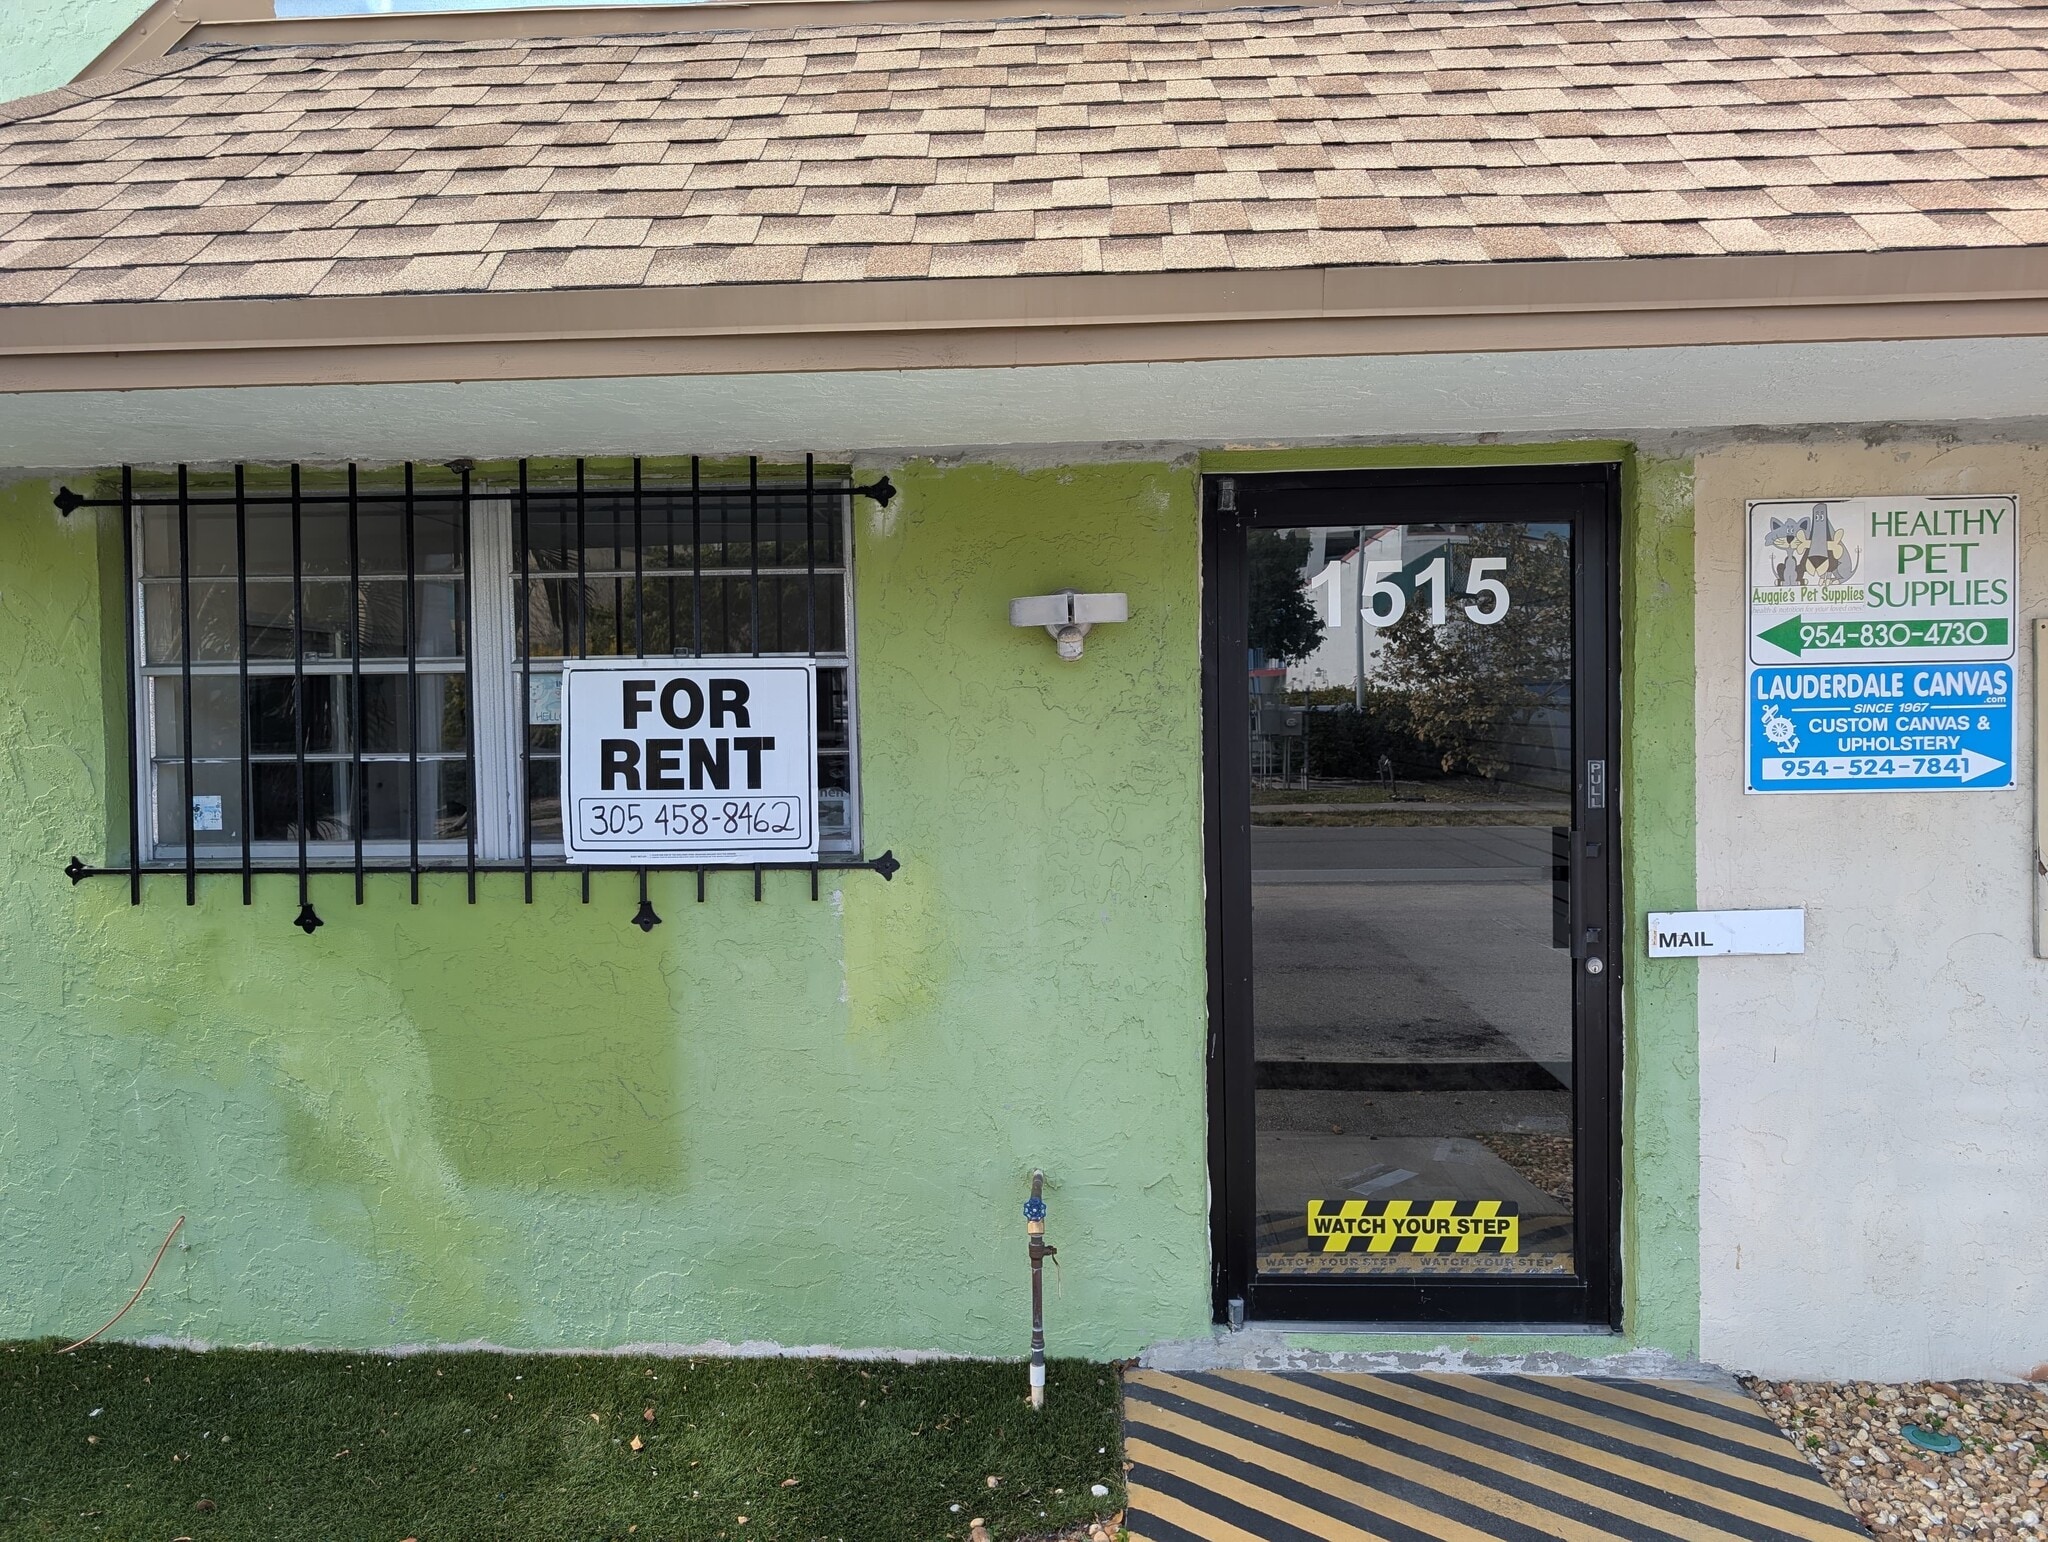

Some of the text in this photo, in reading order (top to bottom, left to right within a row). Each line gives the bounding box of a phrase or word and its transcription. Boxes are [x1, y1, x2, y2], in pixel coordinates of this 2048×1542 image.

[1871, 508, 2006, 537] HEALTHY
[1897, 542, 1979, 574] PET
[1311, 557, 1511, 628] 1515
[1752, 586, 1865, 605] Auggie's Pet Supplies
[1867, 578, 2008, 608] SUPPLIES
[1799, 621, 1988, 648] 954-830-4730
[1757, 670, 2008, 700] LAUDERDALE CANVAS
[622, 677, 752, 730] FOR
[1853, 702, 1930, 713] SINCE 1967
[1808, 716, 1991, 733] CUSTOM CANVAS &
[1838, 735, 1960, 752] UPHOLSTERY
[600, 736, 775, 791] RENT
[1781, 757, 1970, 777] 954-524-7841
[1591, 763, 1601, 808] PULL
[590, 801, 795, 836] 305 458-8462
[1659, 931, 1714, 948] MAIL
[1314, 1218, 1511, 1235] WATCH YOUR STEP
[1265, 1258, 1397, 1267] WATCH YOUR STEP
[1420, 1257, 1554, 1267] WATCH YOUR STEP
